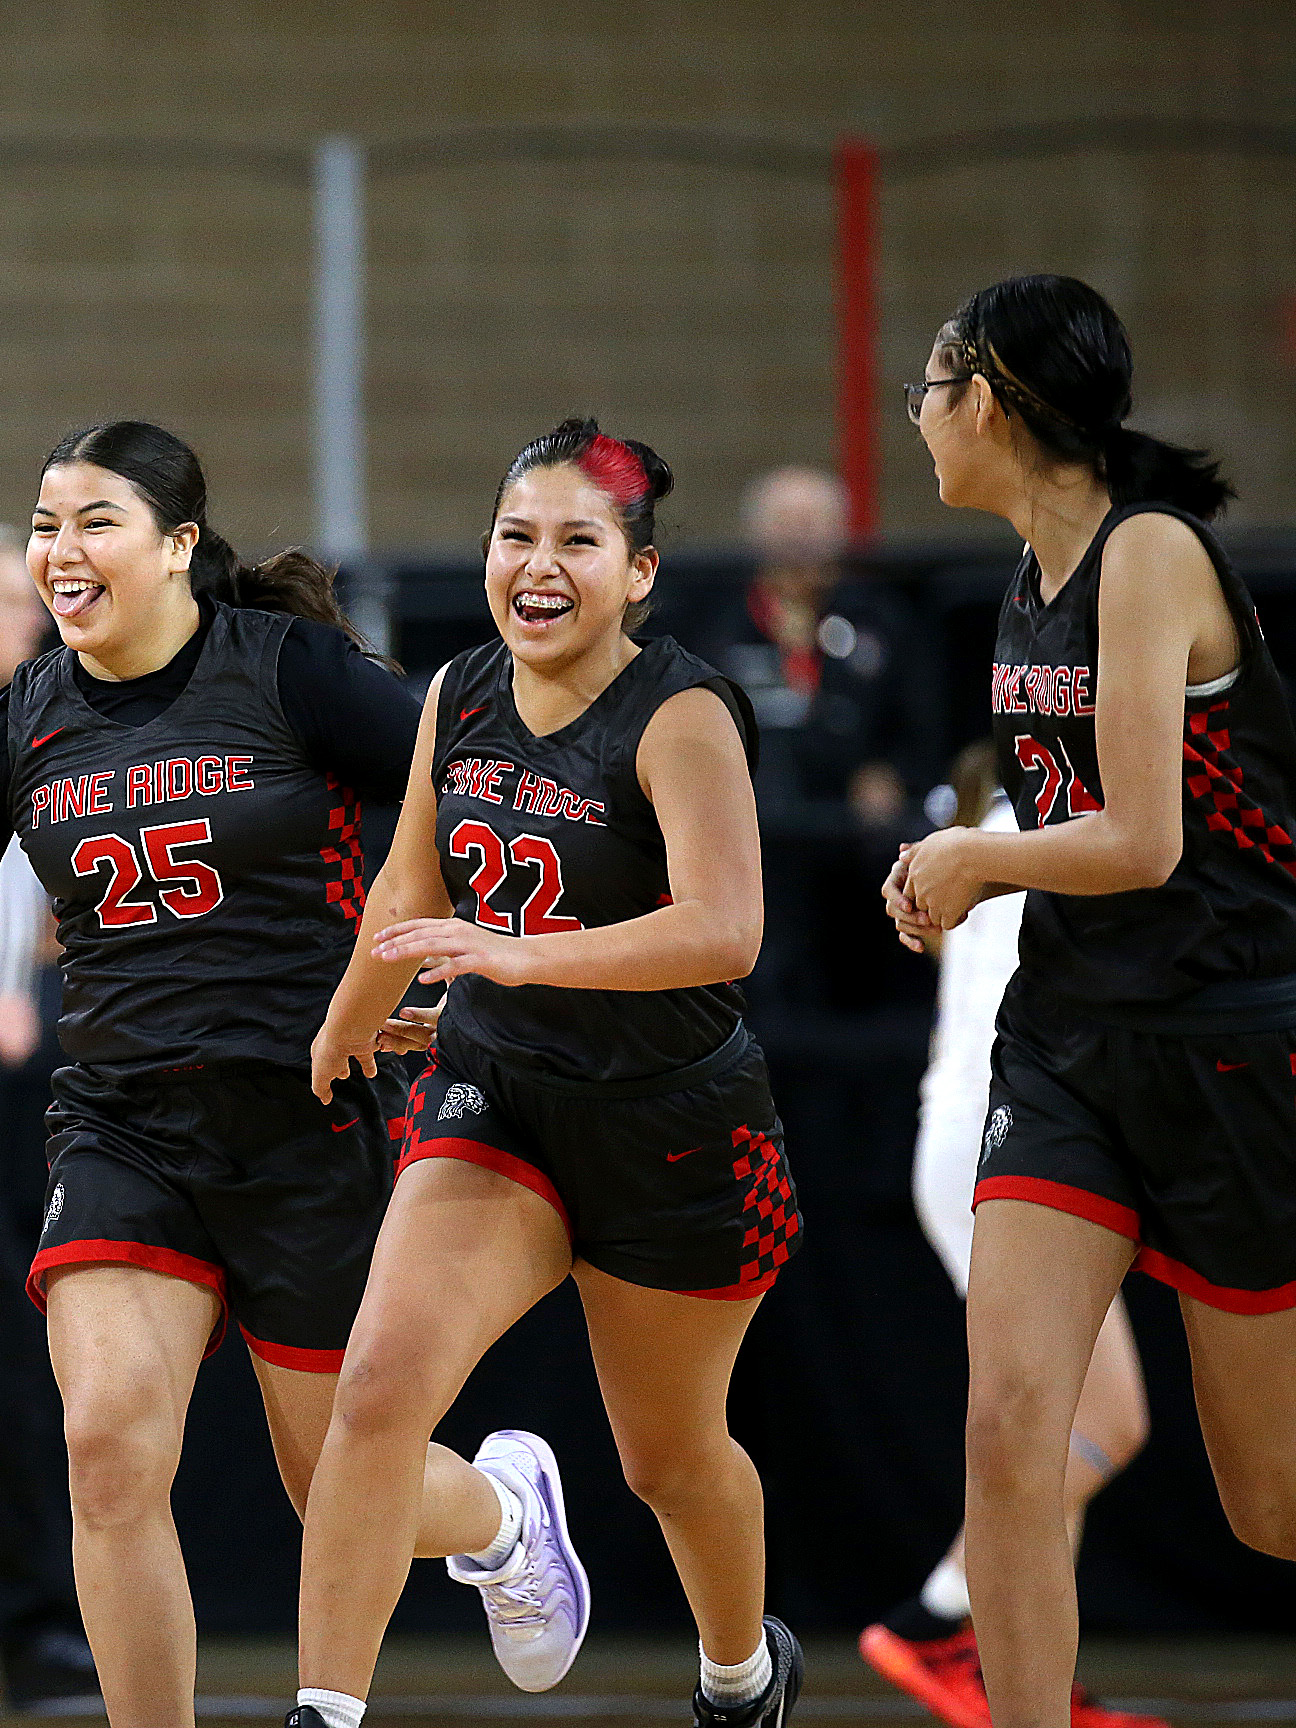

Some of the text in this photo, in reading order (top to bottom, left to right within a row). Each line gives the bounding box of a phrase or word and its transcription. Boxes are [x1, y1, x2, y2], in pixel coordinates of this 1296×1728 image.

[31, 755, 254, 829] PINE RIDGE
[71, 818, 224, 929] 25
[449, 818, 586, 938] 22
